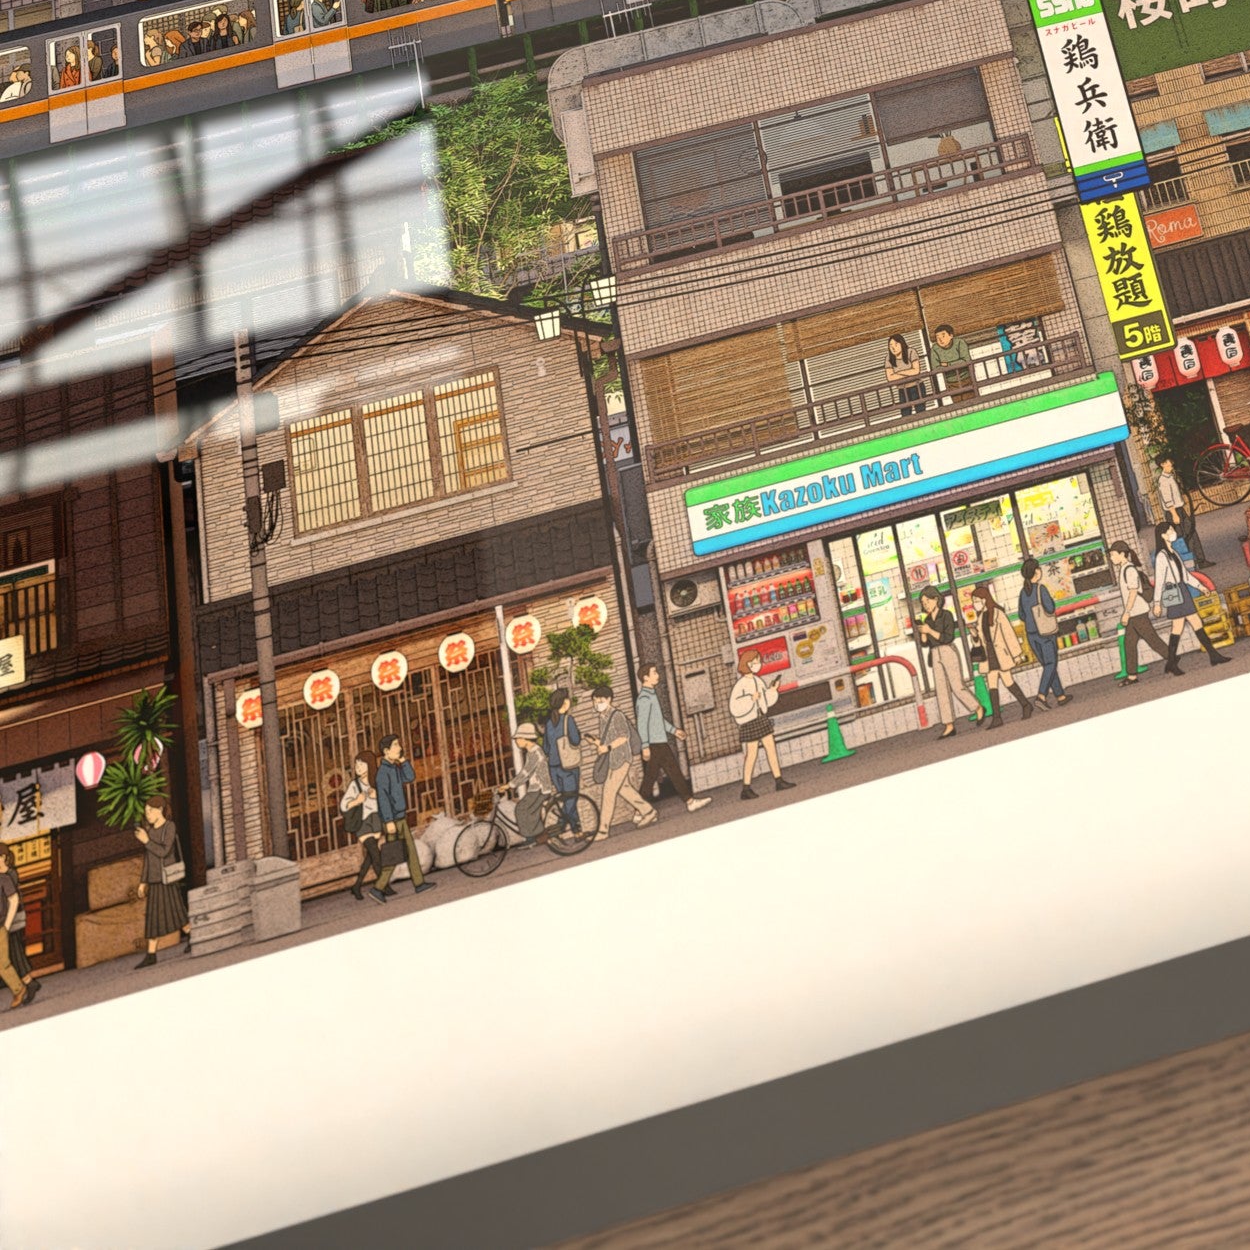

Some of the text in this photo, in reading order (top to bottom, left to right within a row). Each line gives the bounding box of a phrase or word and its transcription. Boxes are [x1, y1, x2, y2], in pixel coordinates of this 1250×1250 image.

[1061, 34, 1119, 153] 鶏兵衛
[1146, 216, 1198, 243] Roma
[1094, 196, 1153, 311] 鶏放題
[1123, 321, 1163, 348] 5階
[703, 452, 924, 531] 家族 Kazoku Mart
[511, 622, 537, 648] 祭
[446, 638, 470, 667] 祭
[377, 658, 401, 685] 祭
[309, 677, 333, 704] 祭
